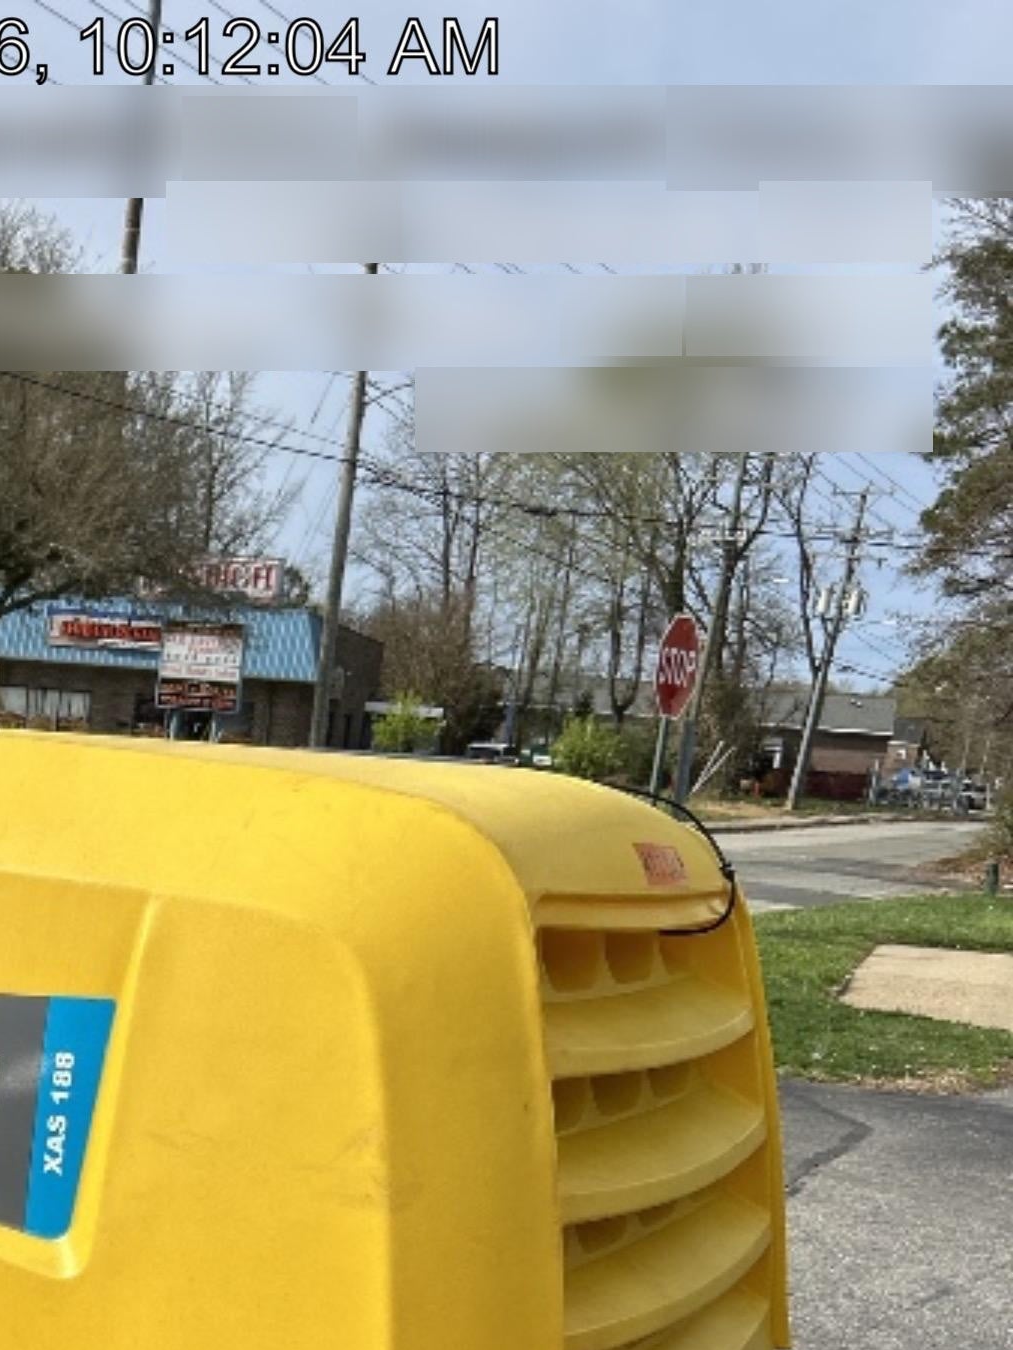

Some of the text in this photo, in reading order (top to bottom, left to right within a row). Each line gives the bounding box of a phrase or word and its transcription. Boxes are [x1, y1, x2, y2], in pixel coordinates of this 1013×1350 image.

[659, 647, 696, 688] STOP
[42, 1051, 75, 1176] XAS 188
